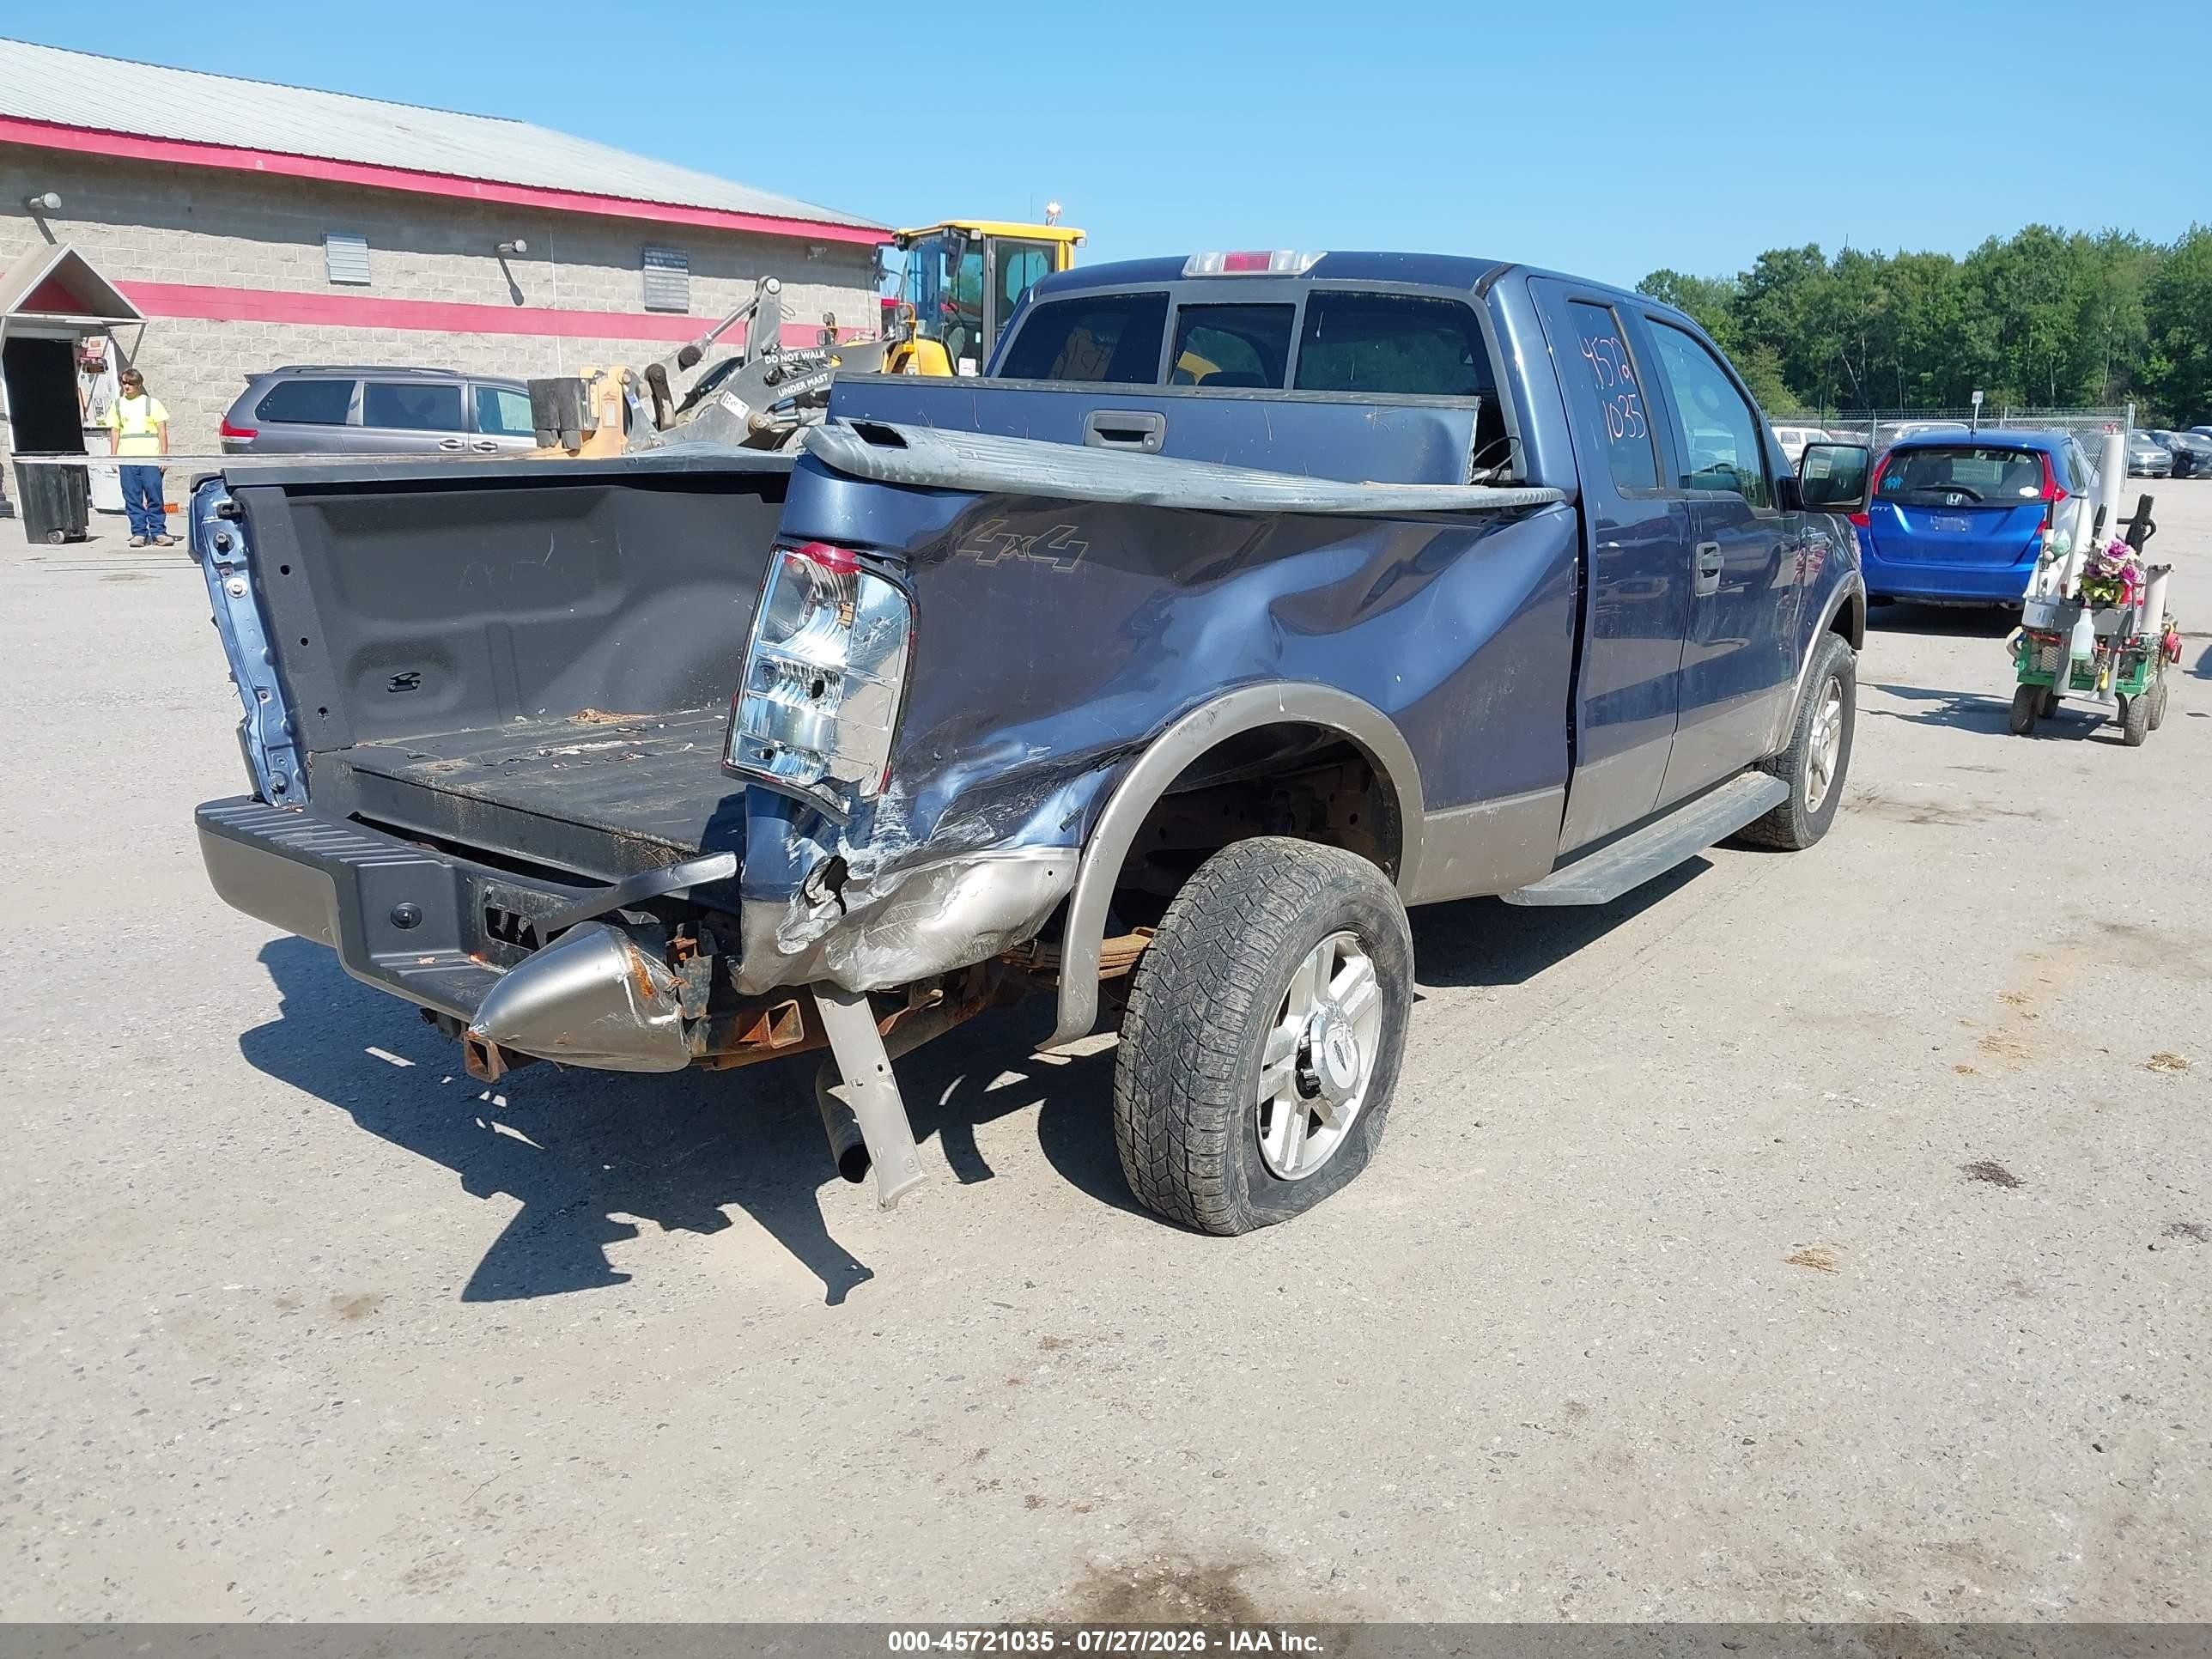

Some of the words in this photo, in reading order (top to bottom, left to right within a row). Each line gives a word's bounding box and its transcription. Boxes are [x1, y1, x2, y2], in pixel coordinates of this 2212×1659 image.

[764, 355, 779, 365] DO
[780, 352, 799, 362] NOT
[800, 349, 827, 360] WALK
[777, 382, 807, 398] UNDER
[806, 373, 829, 387] MAST
[1601, 393, 1647, 447] 1035
